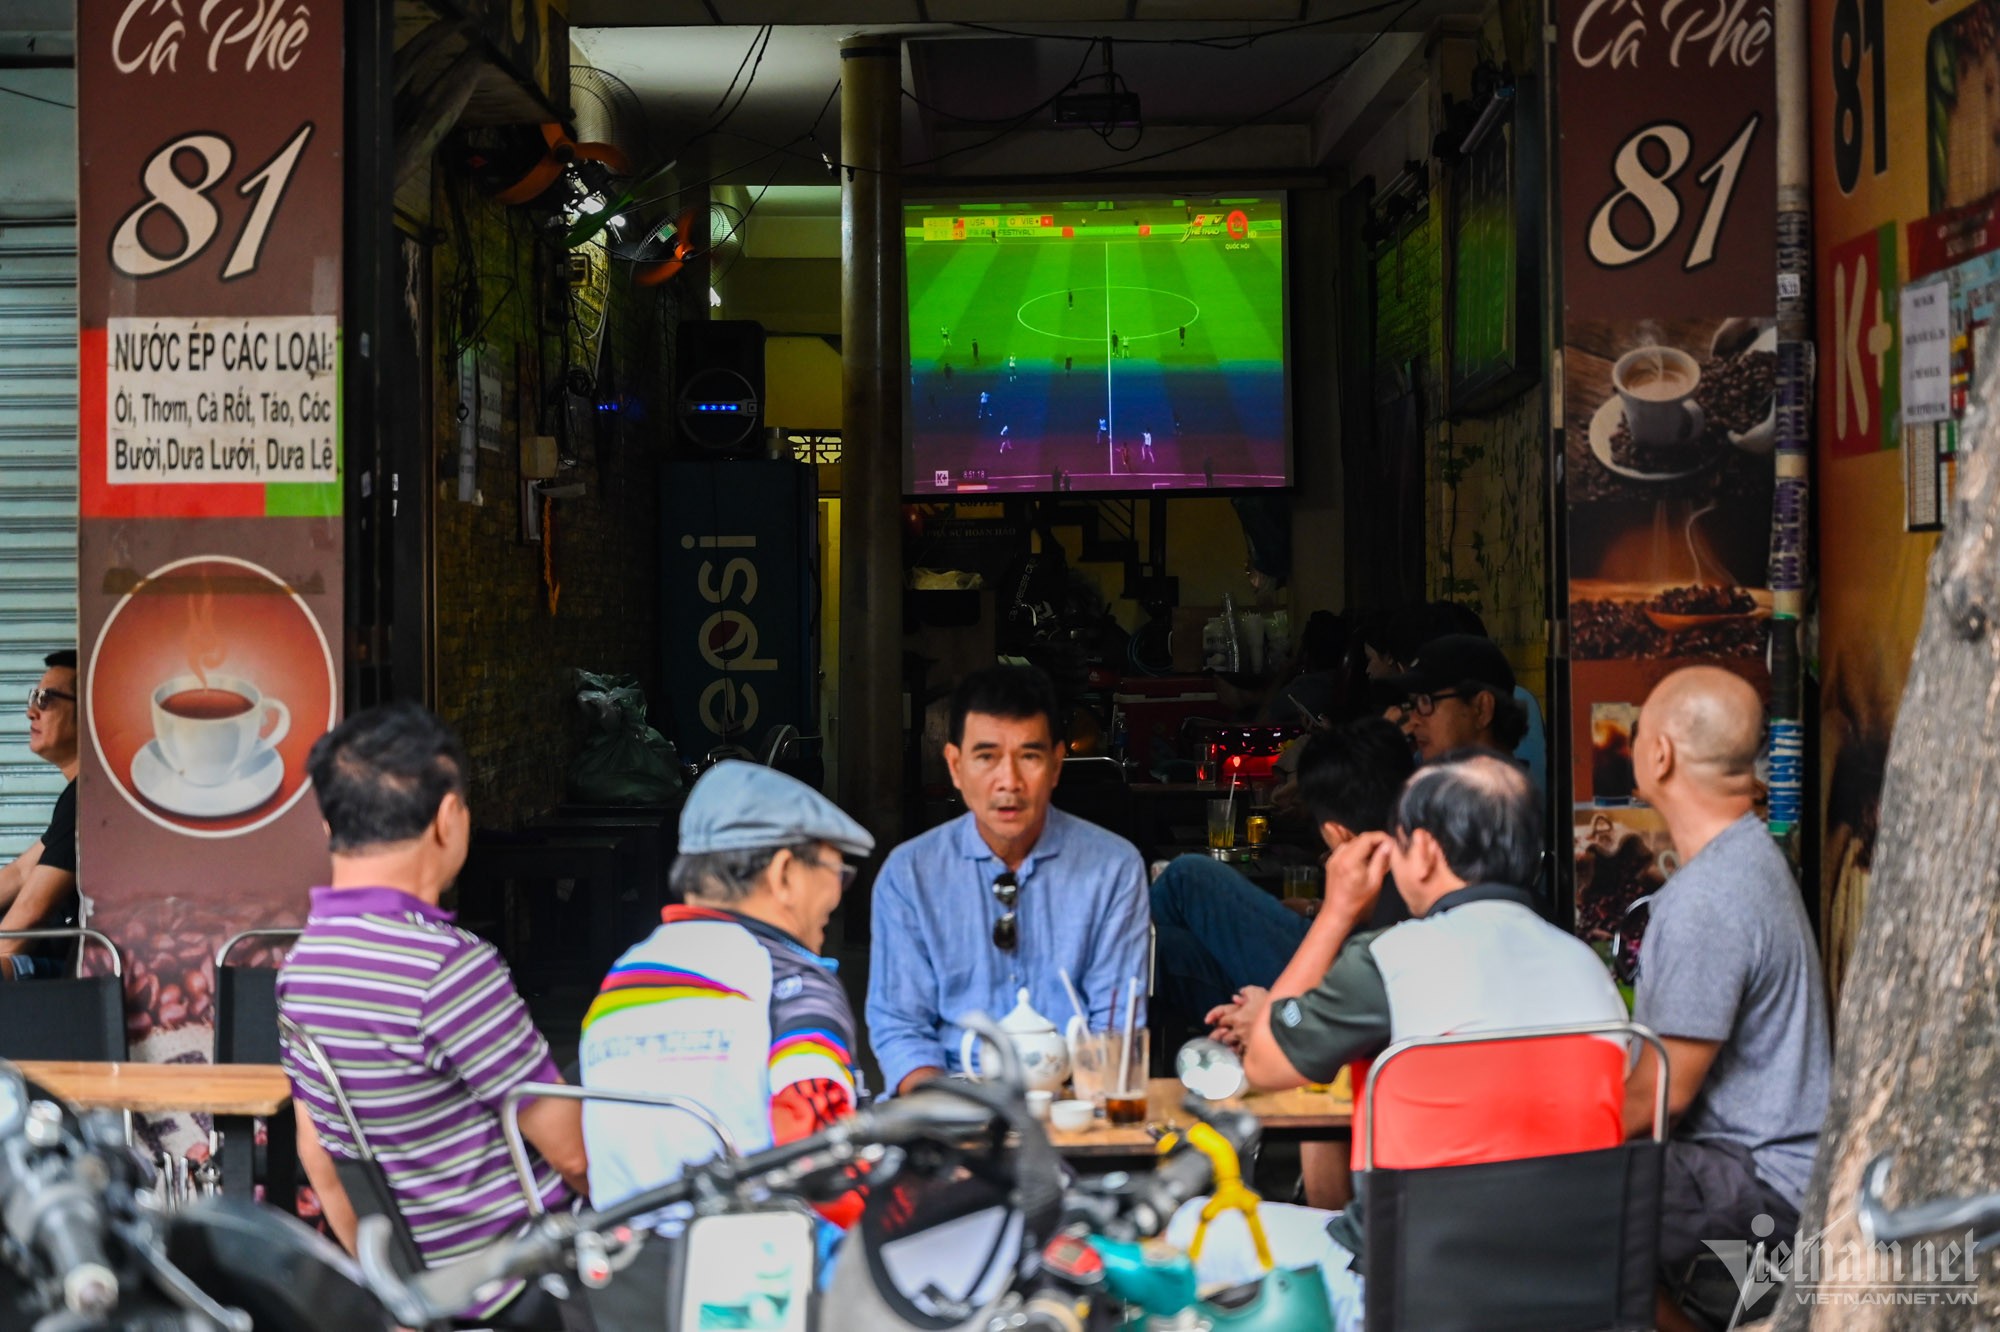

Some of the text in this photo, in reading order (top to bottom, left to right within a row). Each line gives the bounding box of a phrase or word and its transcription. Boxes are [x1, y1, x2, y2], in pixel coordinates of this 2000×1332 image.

[112, 0, 311, 74] Cà Phê
[1573, 0, 1772, 69] Cà Phê
[1832, 0, 1887, 195] 81
[108, 121, 315, 283] 81
[1586, 110, 1762, 273] 81
[115, 322, 333, 380] NƯỚC ÉP CÁC LOẠI:
[1835, 253, 1893, 441] K+
[142, 393, 192, 428] Thơm,
[223, 386, 256, 428] Rốt,
[299, 391, 331, 423] Cóc
[211, 437, 260, 476] Lưới,
[267, 438, 304, 470] Dưa
[312, 437, 333, 470] Lê
[681, 534, 778, 760] epsi
